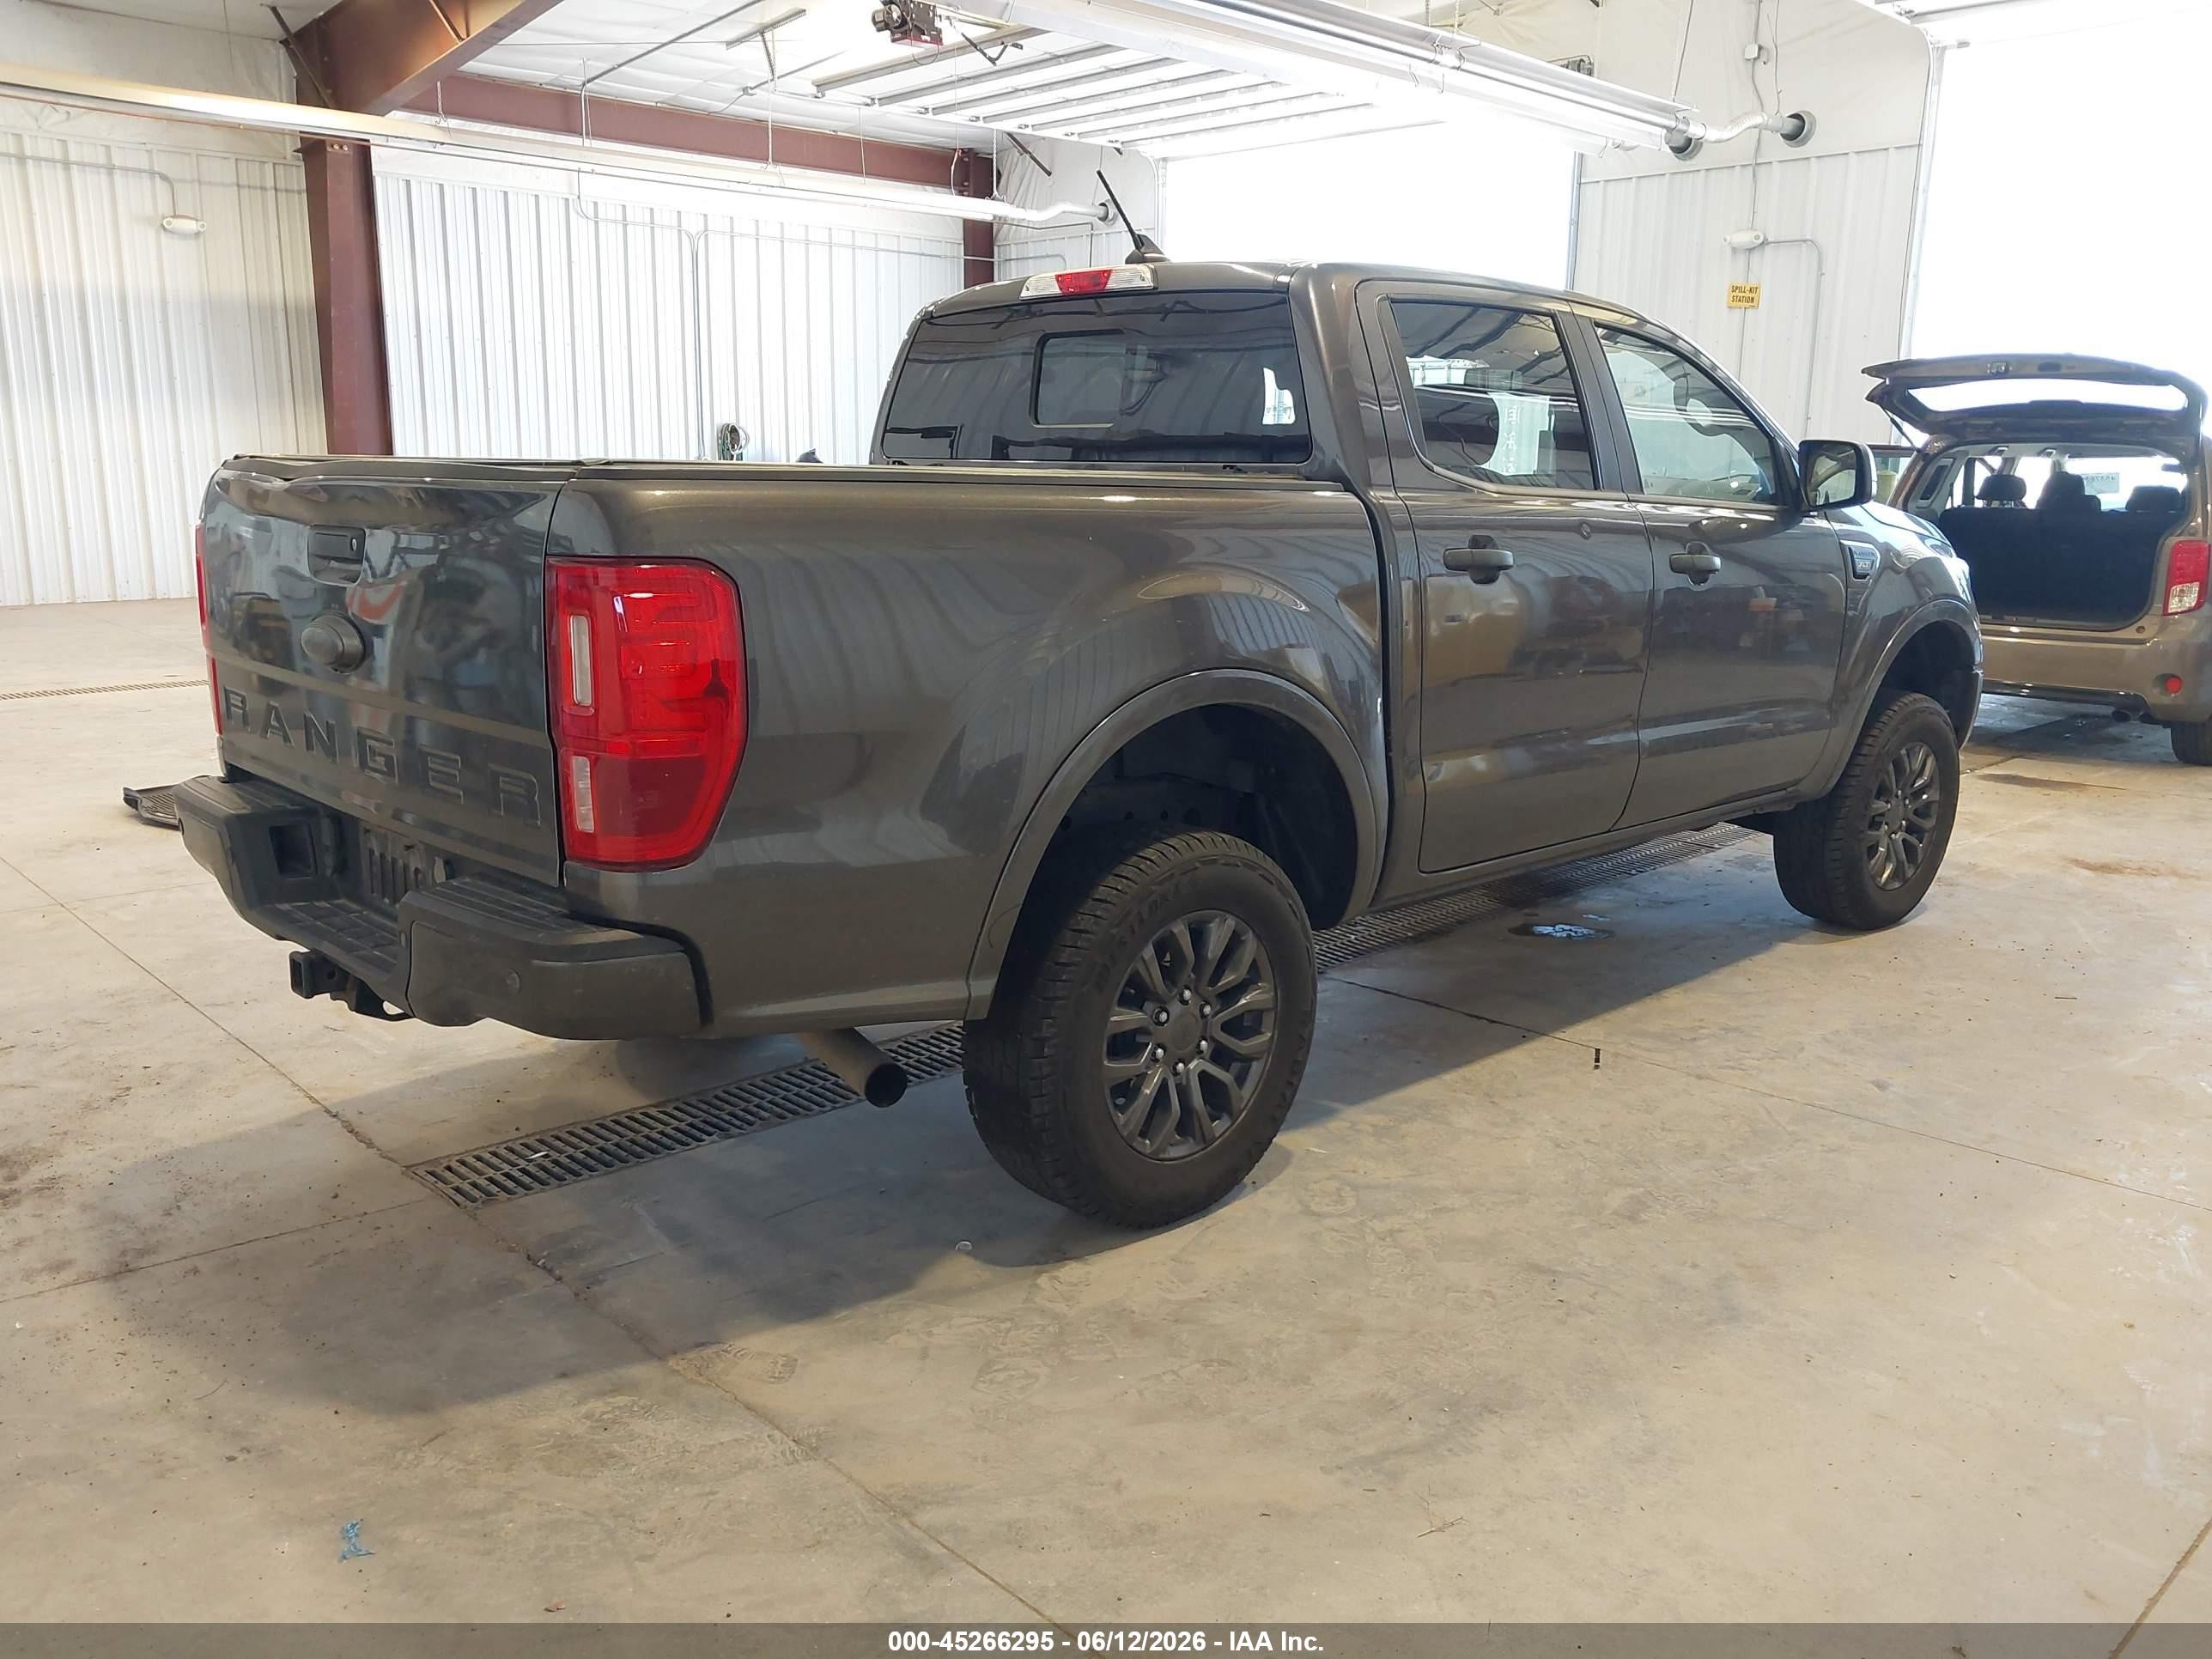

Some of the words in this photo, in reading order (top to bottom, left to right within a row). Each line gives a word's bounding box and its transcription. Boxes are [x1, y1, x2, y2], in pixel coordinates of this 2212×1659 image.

[1731, 285, 1759, 295] SPILL-KIT
[1731, 295, 1755, 304] STATION
[224, 686, 541, 826] RANGER
